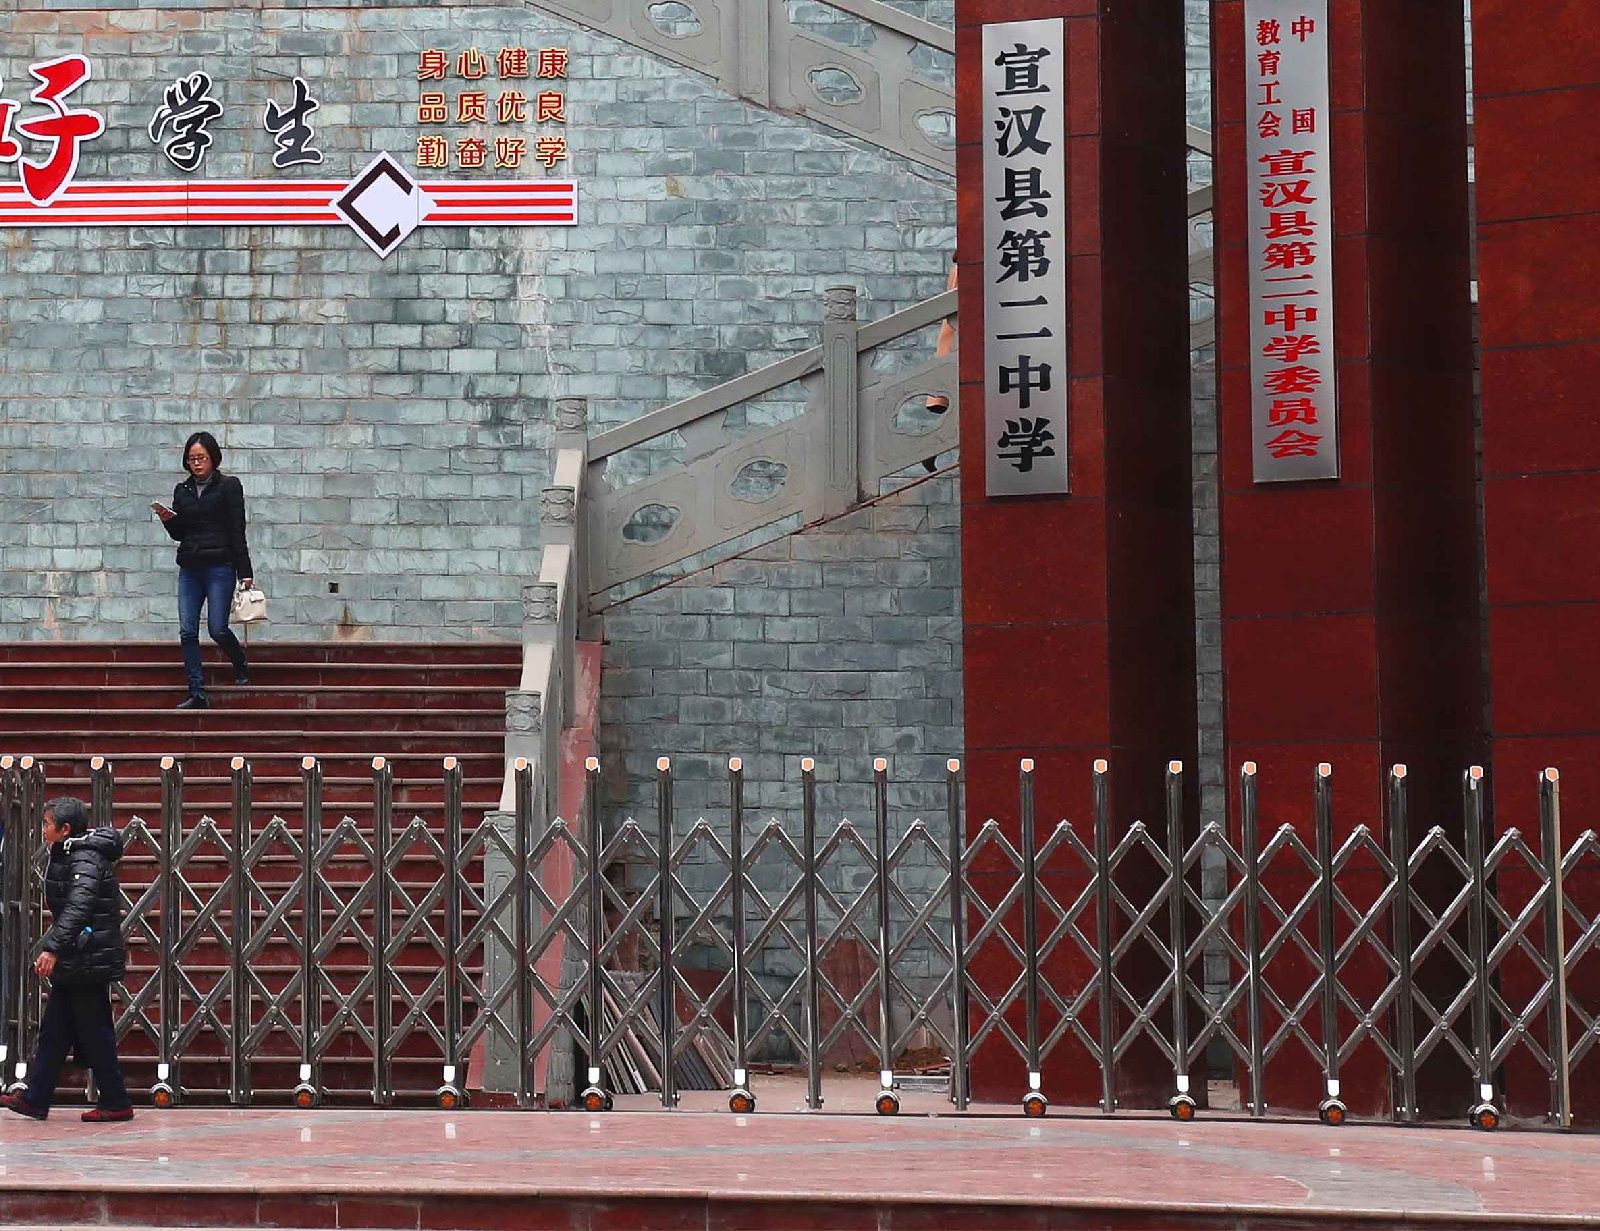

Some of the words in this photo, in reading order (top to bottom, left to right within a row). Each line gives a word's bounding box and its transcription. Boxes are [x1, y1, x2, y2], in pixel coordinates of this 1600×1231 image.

[417, 47, 568, 80] 身心健康
[417, 90, 566, 123] 品质优良
[1255, 19, 1282, 139] 教育工会
[1290, 15, 1316, 134] 中国
[417, 135, 567, 168] 勤奋好学
[994, 43, 1056, 473] 宣汉县第二中学
[1257, 148, 1323, 459] 宣汉县第二中学委员会
